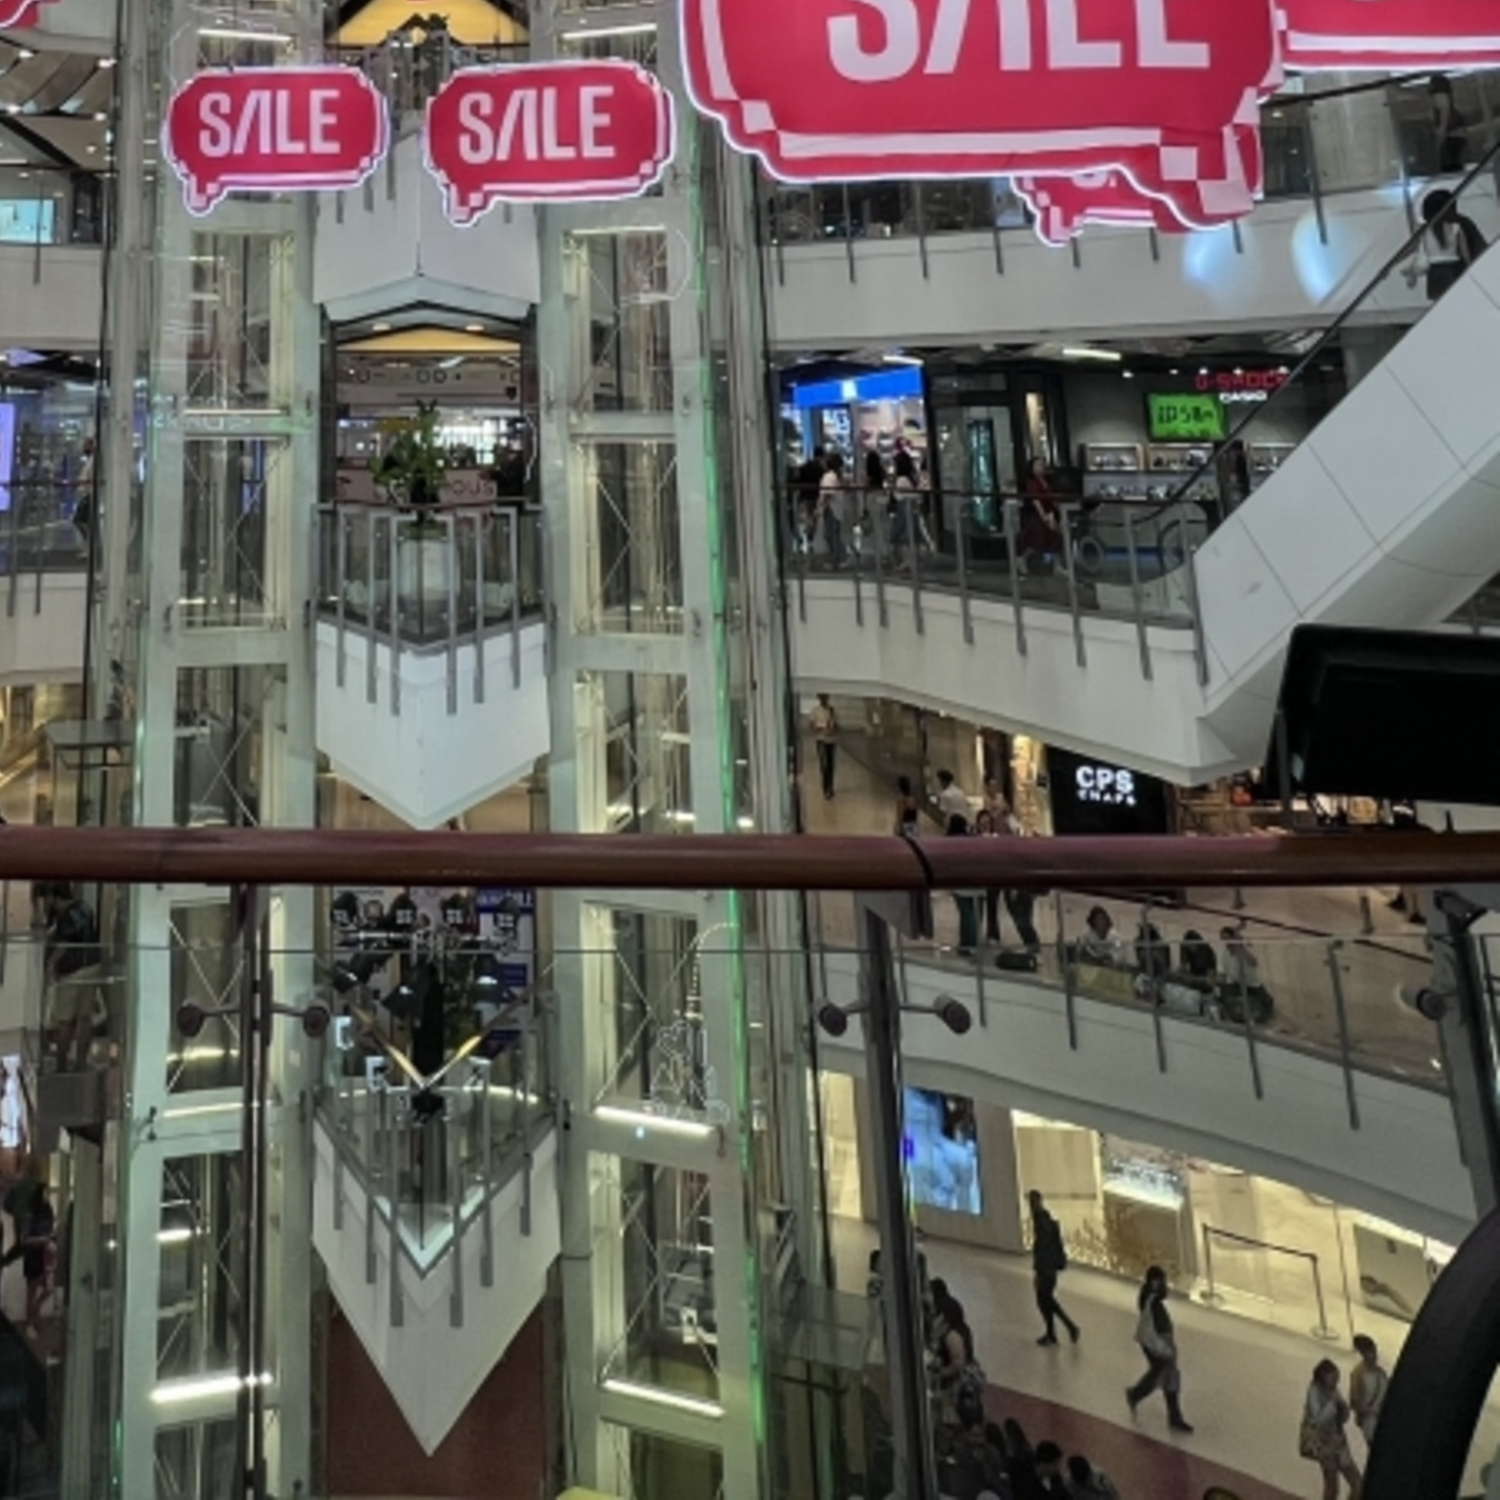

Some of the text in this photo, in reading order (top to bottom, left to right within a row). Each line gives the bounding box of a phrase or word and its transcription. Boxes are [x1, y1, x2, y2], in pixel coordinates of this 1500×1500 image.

[200, 89, 341, 157] SALE
[458, 85, 616, 164] SALE
[1076, 766, 1134, 794] CPS
